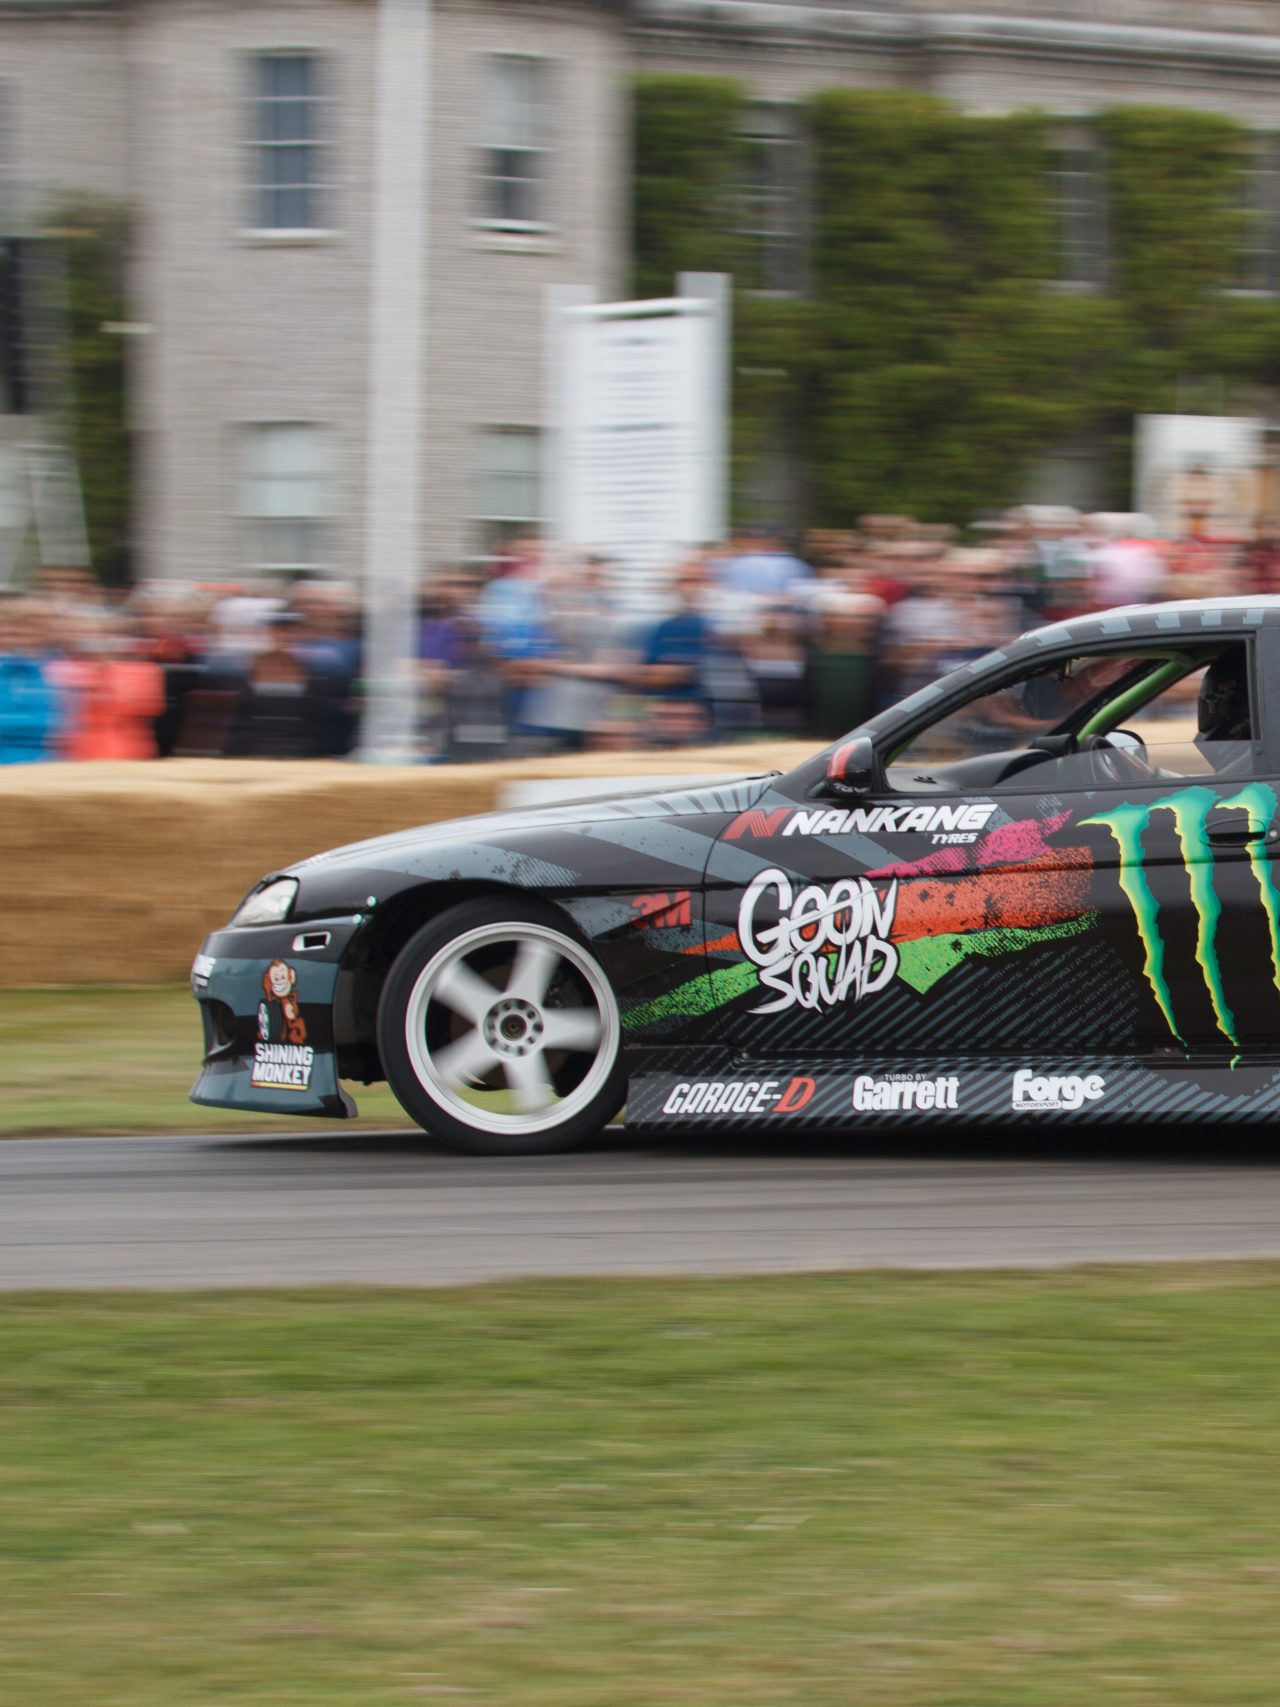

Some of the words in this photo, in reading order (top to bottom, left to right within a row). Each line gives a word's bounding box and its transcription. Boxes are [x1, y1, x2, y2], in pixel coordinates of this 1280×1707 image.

[782, 803, 998, 836] NANKANG
[931, 832, 979, 845] TYRES
[737, 867, 898, 968] GOON
[746, 934, 899, 1014] SQUAD
[255, 1042, 314, 1065] SHINING
[252, 1062, 311, 1085] MONKEY
[884, 1073, 913, 1081] TURBO
[915, 1073, 927, 1081] BY
[663, 1077, 816, 1114] GARAGE-D
[853, 1075, 960, 1111] Garrett
